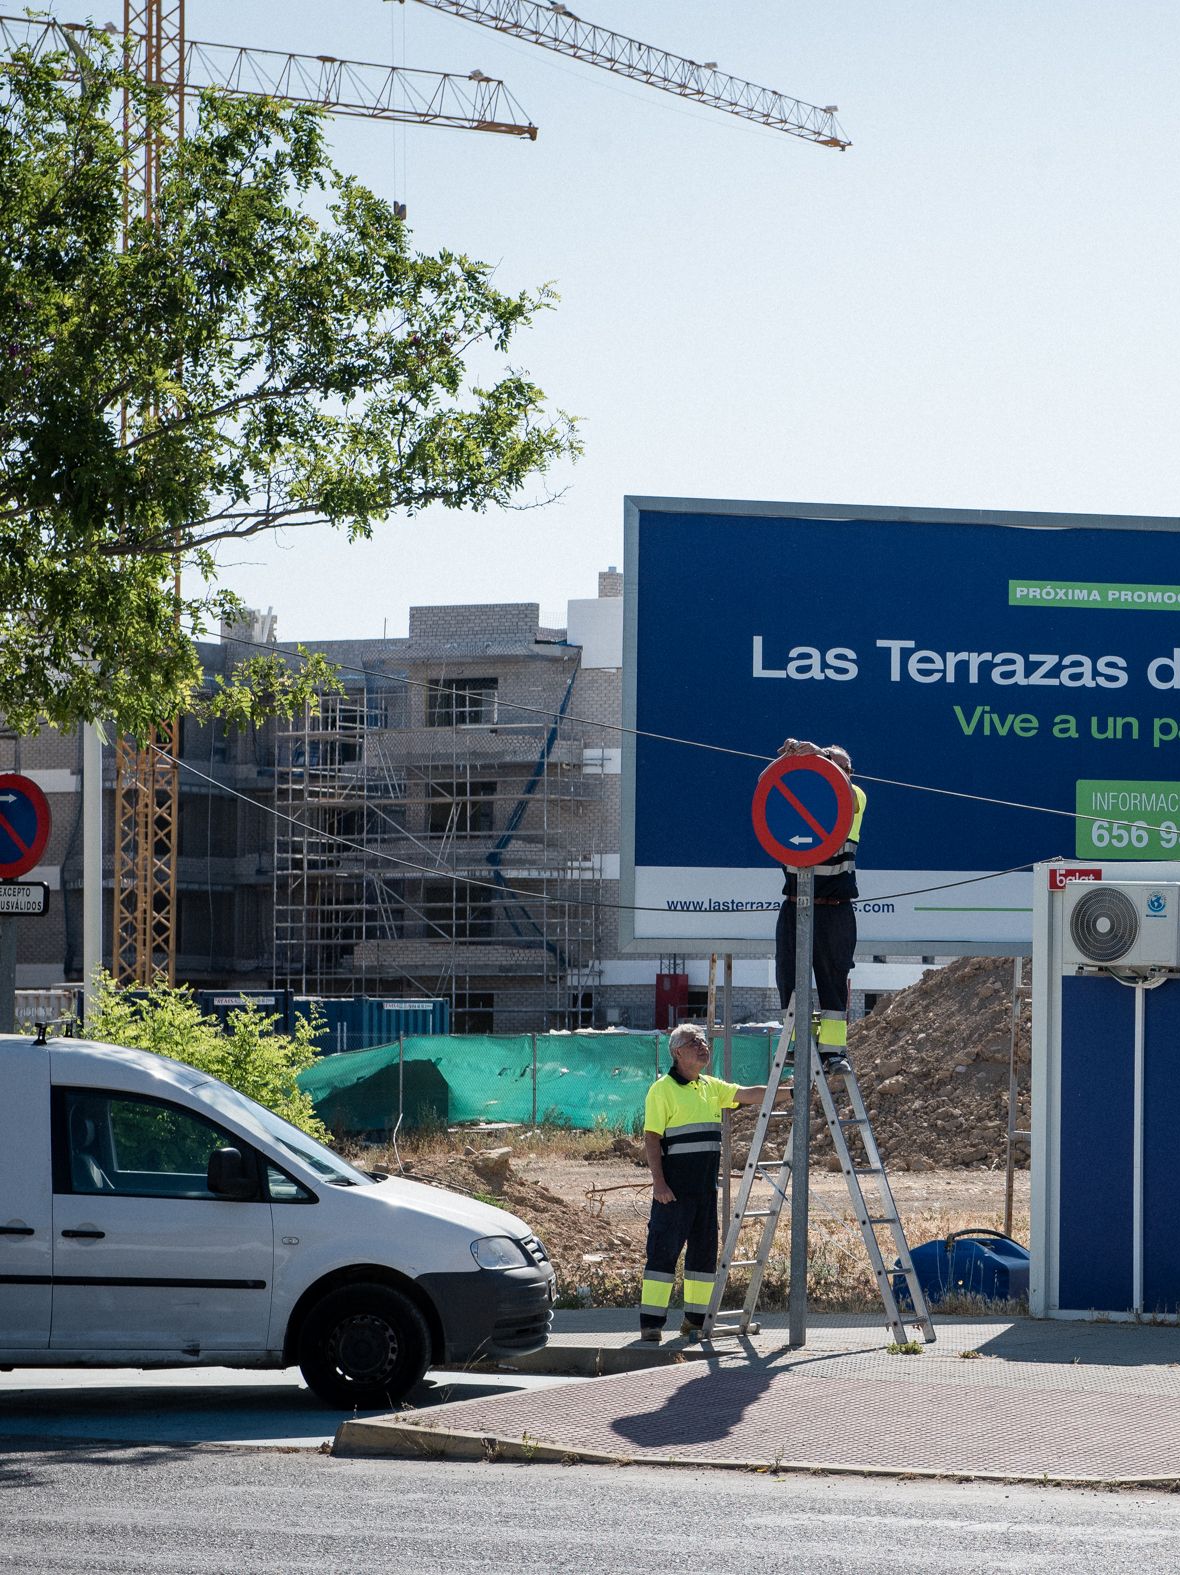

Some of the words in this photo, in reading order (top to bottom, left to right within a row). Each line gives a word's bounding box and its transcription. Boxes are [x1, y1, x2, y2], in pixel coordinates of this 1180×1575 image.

[1016, 585, 1101, 601] PRÓXIMA
[752, 635, 858, 681] Las
[876, 639, 1128, 688] Terrazas
[953, 705, 1039, 736] Vive
[1052, 714, 1078, 738] a
[1091, 716, 1139, 739] un
[1091, 820, 1149, 848] 656
[0, 898, 42, 911] USVÁLIDOS
